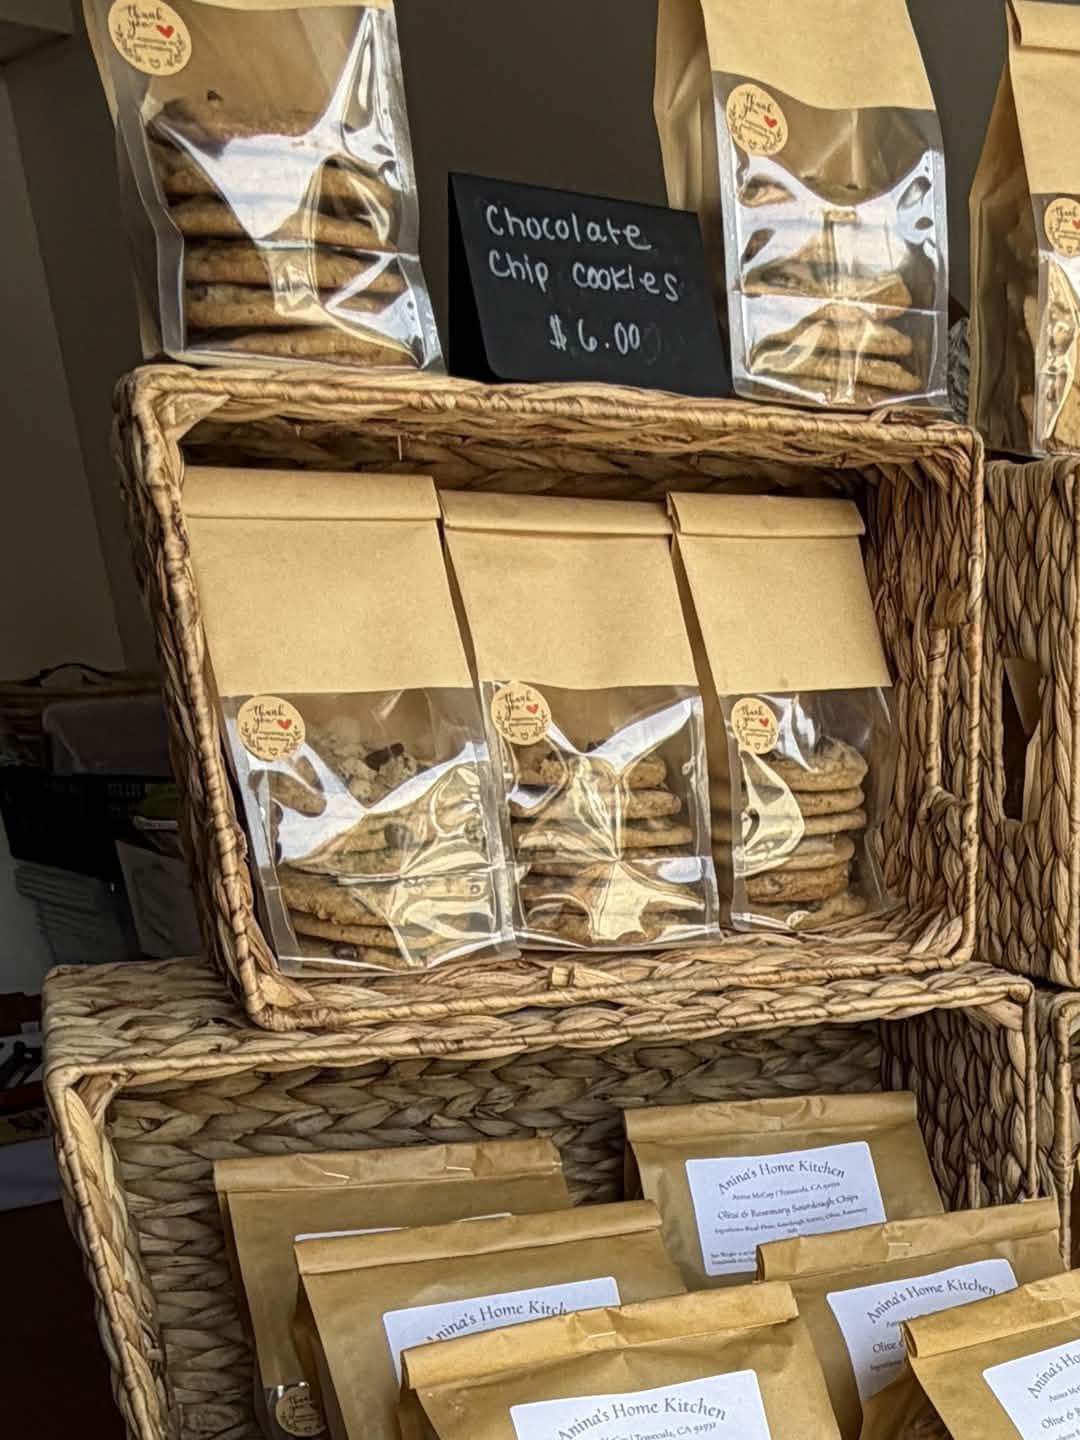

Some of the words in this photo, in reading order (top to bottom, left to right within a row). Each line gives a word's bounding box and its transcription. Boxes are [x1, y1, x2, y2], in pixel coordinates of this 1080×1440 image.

[486, 204, 652, 250] Chocolate
[489, 250, 549, 293] Chip
[572, 262, 680, 302] cookies
[717, 1167, 758, 1196] Anina's
[760, 1162, 795, 1177] Home
[799, 1159, 846, 1180] Kitchen
[480, 1301, 524, 1322] Home
[866, 1292, 907, 1324] Anina's
[906, 1283, 945, 1300] Home
[946, 1278, 997, 1296] Kitchen
[1027, 1359, 1064, 1400] Anina's
[612, 1401, 658, 1421] Home
[663, 1397, 727, 1422] Kitchen
